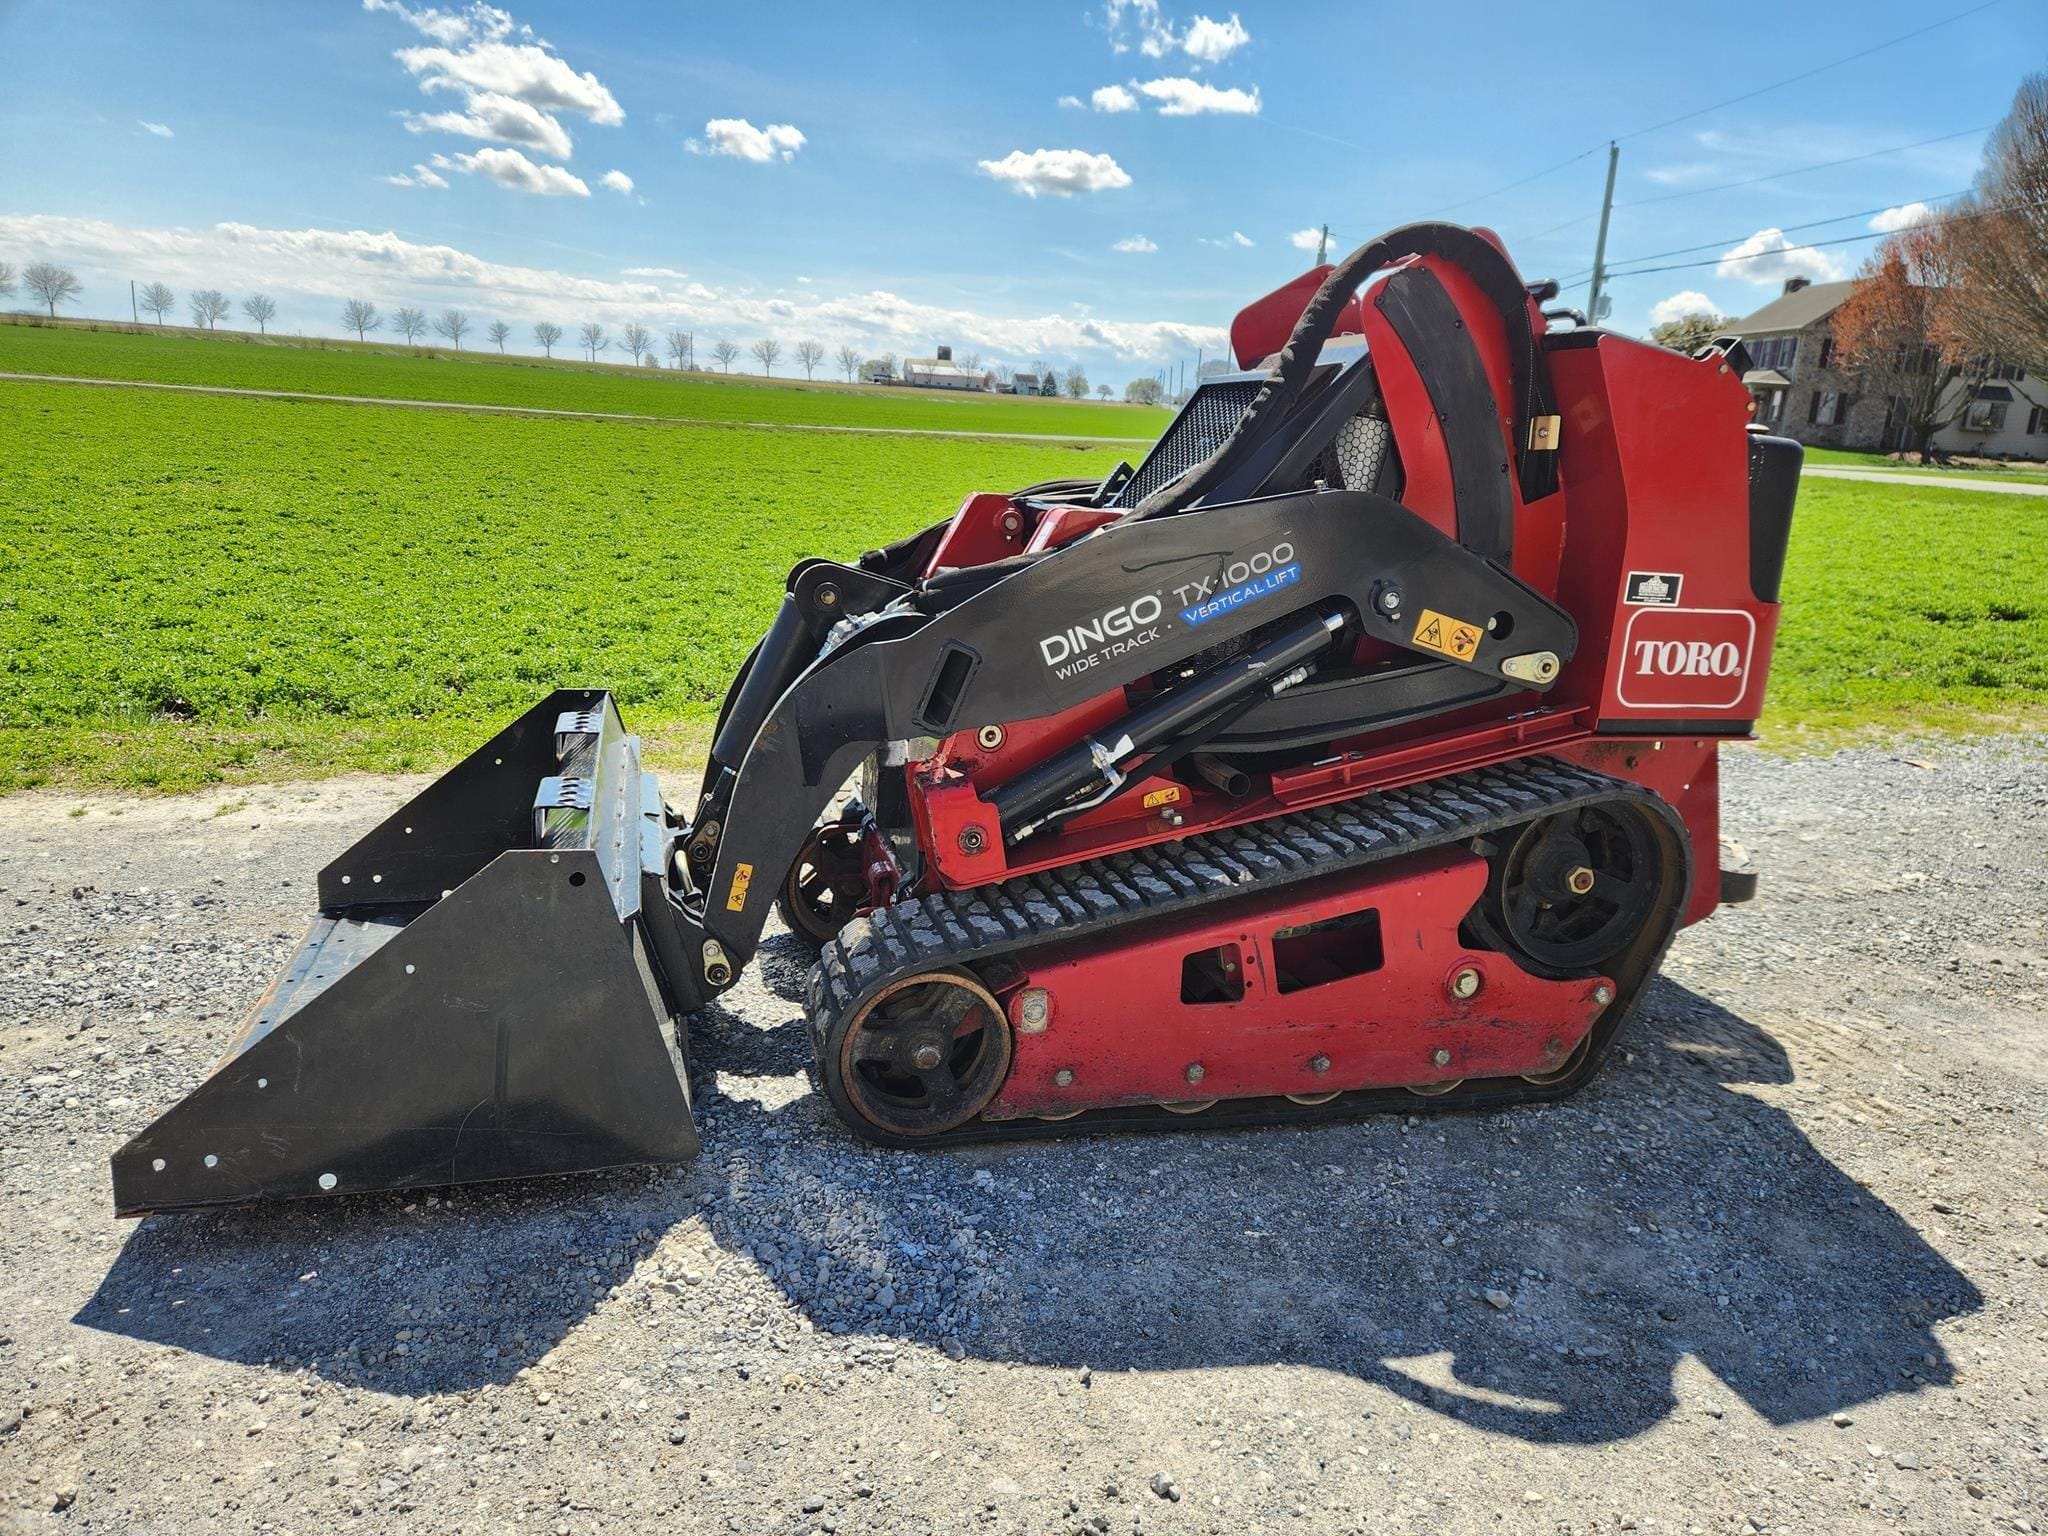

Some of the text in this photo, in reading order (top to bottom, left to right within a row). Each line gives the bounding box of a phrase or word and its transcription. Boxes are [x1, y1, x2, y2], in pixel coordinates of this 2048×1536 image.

[1186, 566, 1297, 623] VERTICAL LIFT
[1040, 594, 1162, 666] DINGO
[1054, 627, 1161, 681] WIDE TRACK
[1634, 640, 1741, 677] TORO
